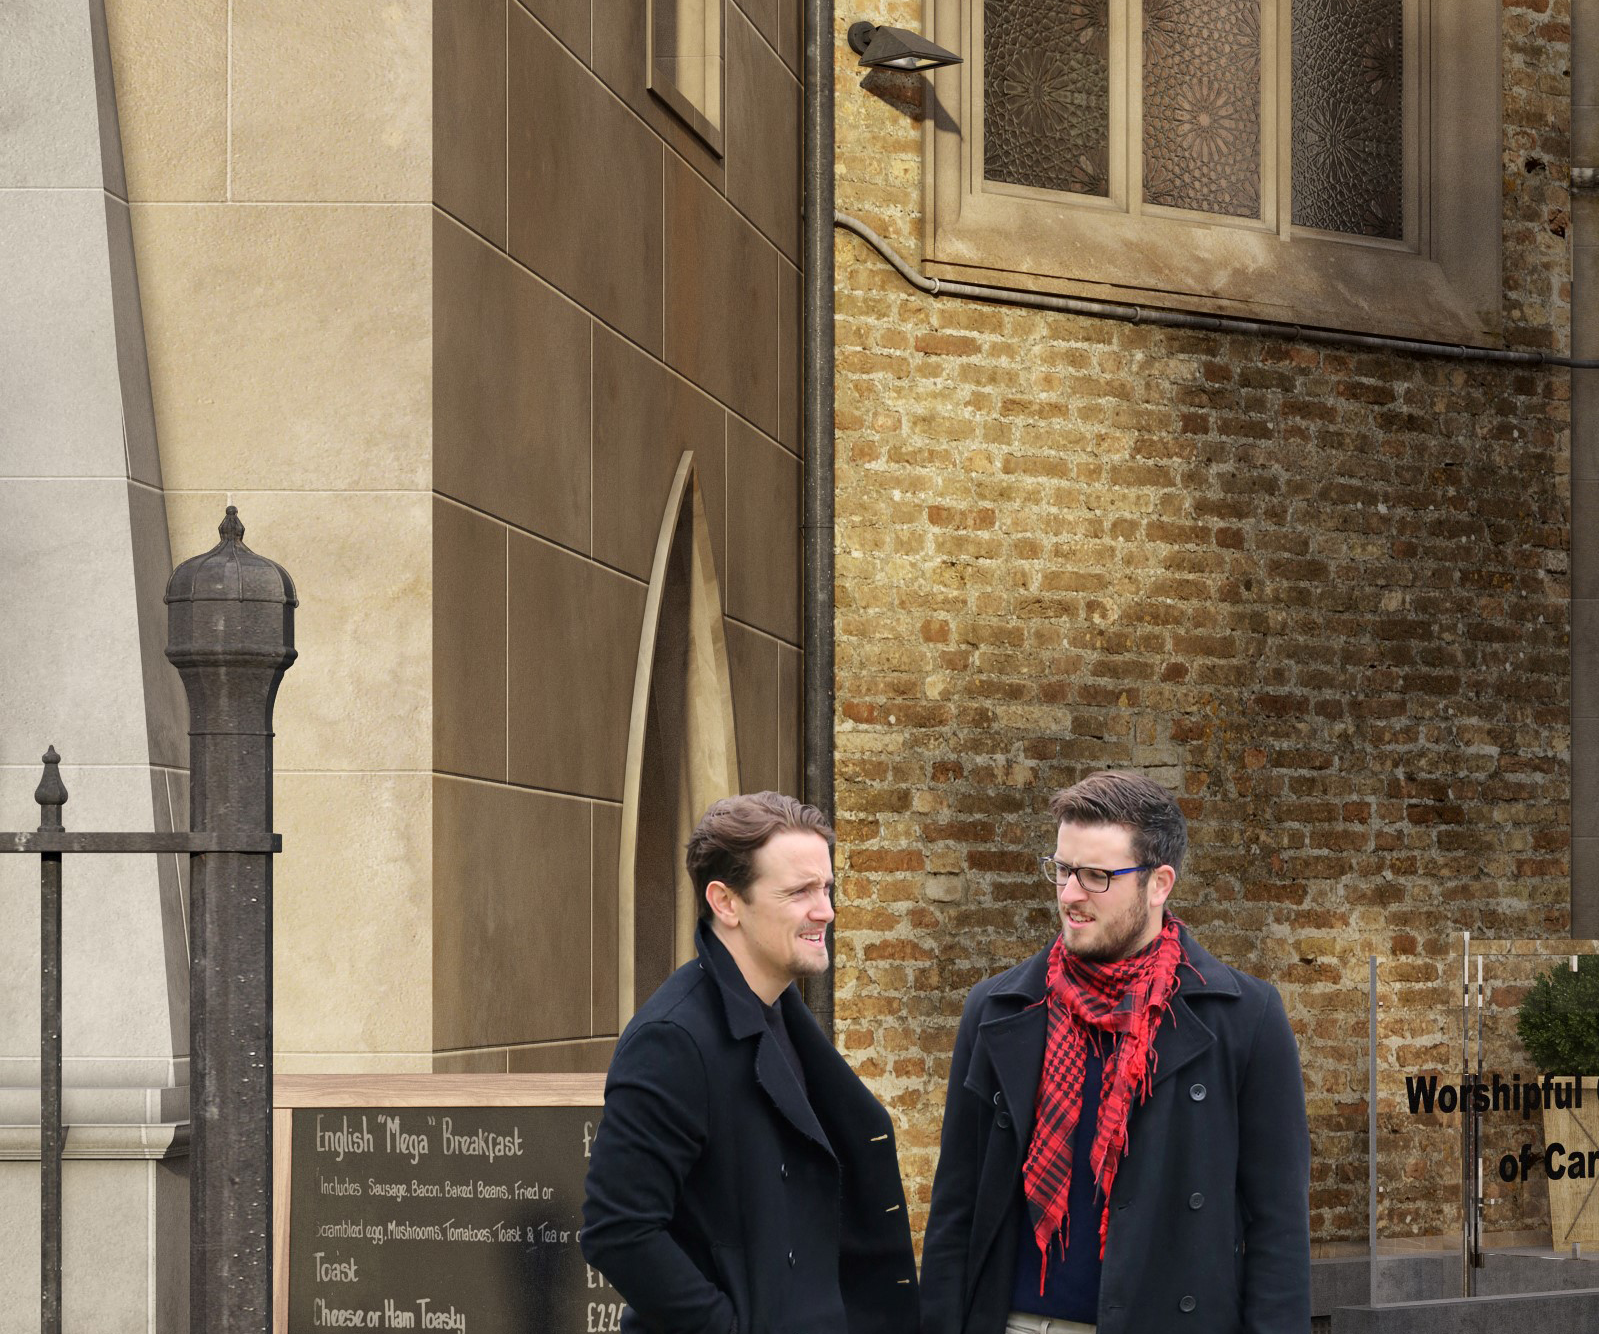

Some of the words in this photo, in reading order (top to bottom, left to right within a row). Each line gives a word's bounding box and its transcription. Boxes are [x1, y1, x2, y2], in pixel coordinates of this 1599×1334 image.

[1405, 1071, 1583, 1120] Worshipful
[315, 1115, 374, 1162] English
[442, 1116, 524, 1163] Breakfast
[1499, 1143, 1533, 1183] of
[319, 1175, 362, 1197] Includes
[444, 1179, 474, 1199] Baked
[514, 1180, 539, 1201] Fried
[542, 1185, 555, 1201] or
[493, 1220, 522, 1243] Toast
[526, 1226, 535, 1242] &
[538, 1221, 557, 1244] Tea
[559, 1229, 571, 1244] or
[312, 1251, 360, 1283] Toast
[312, 1297, 365, 1328] Cheese
[366, 1310, 383, 1329] or
[383, 1298, 415, 1329] Ham
